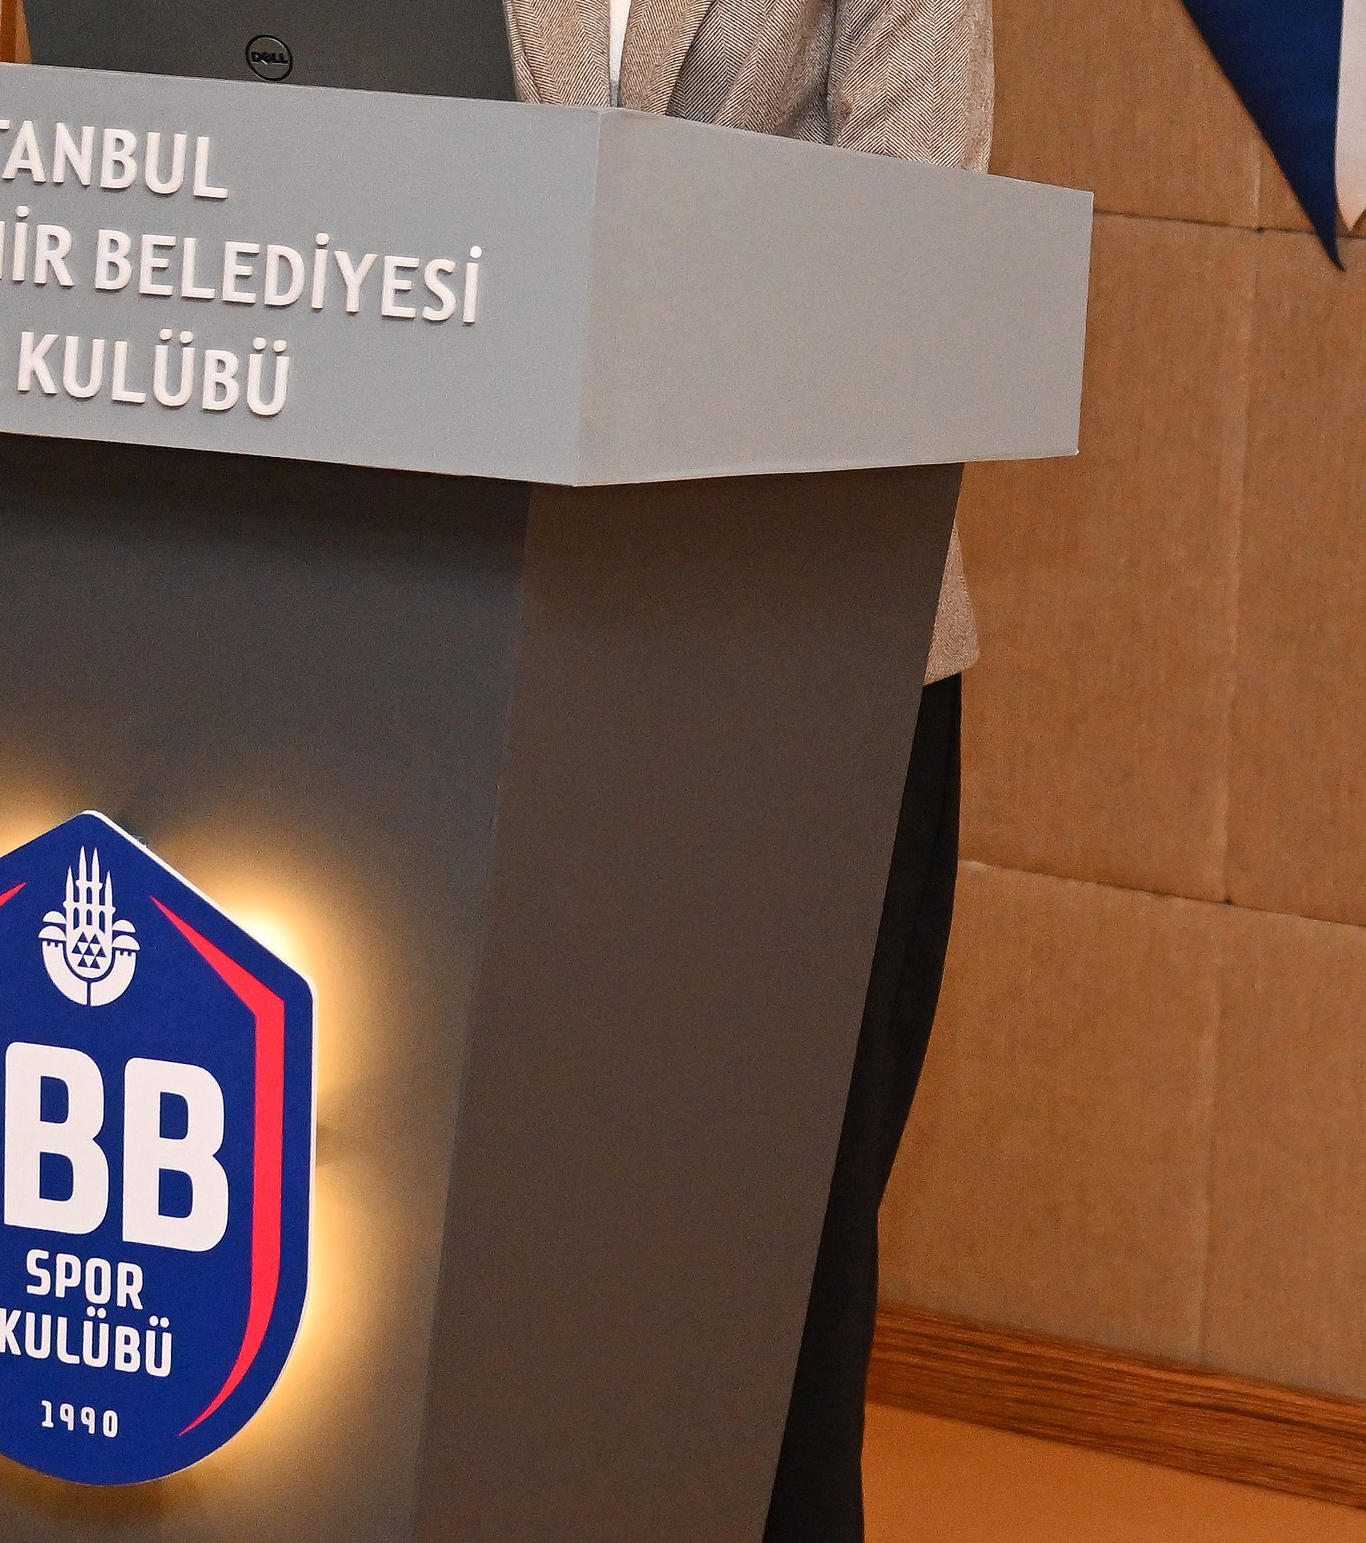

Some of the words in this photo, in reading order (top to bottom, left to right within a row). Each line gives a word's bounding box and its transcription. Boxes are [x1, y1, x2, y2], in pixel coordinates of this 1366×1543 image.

[250, 51, 289, 64] DELL
[93, 232, 482, 325] BELEDİYESİ
[17, 327, 291, 417] KULÜBÜ
[25, 1249, 144, 1310] SPOR
[40, 1400, 119, 1439] 1990
